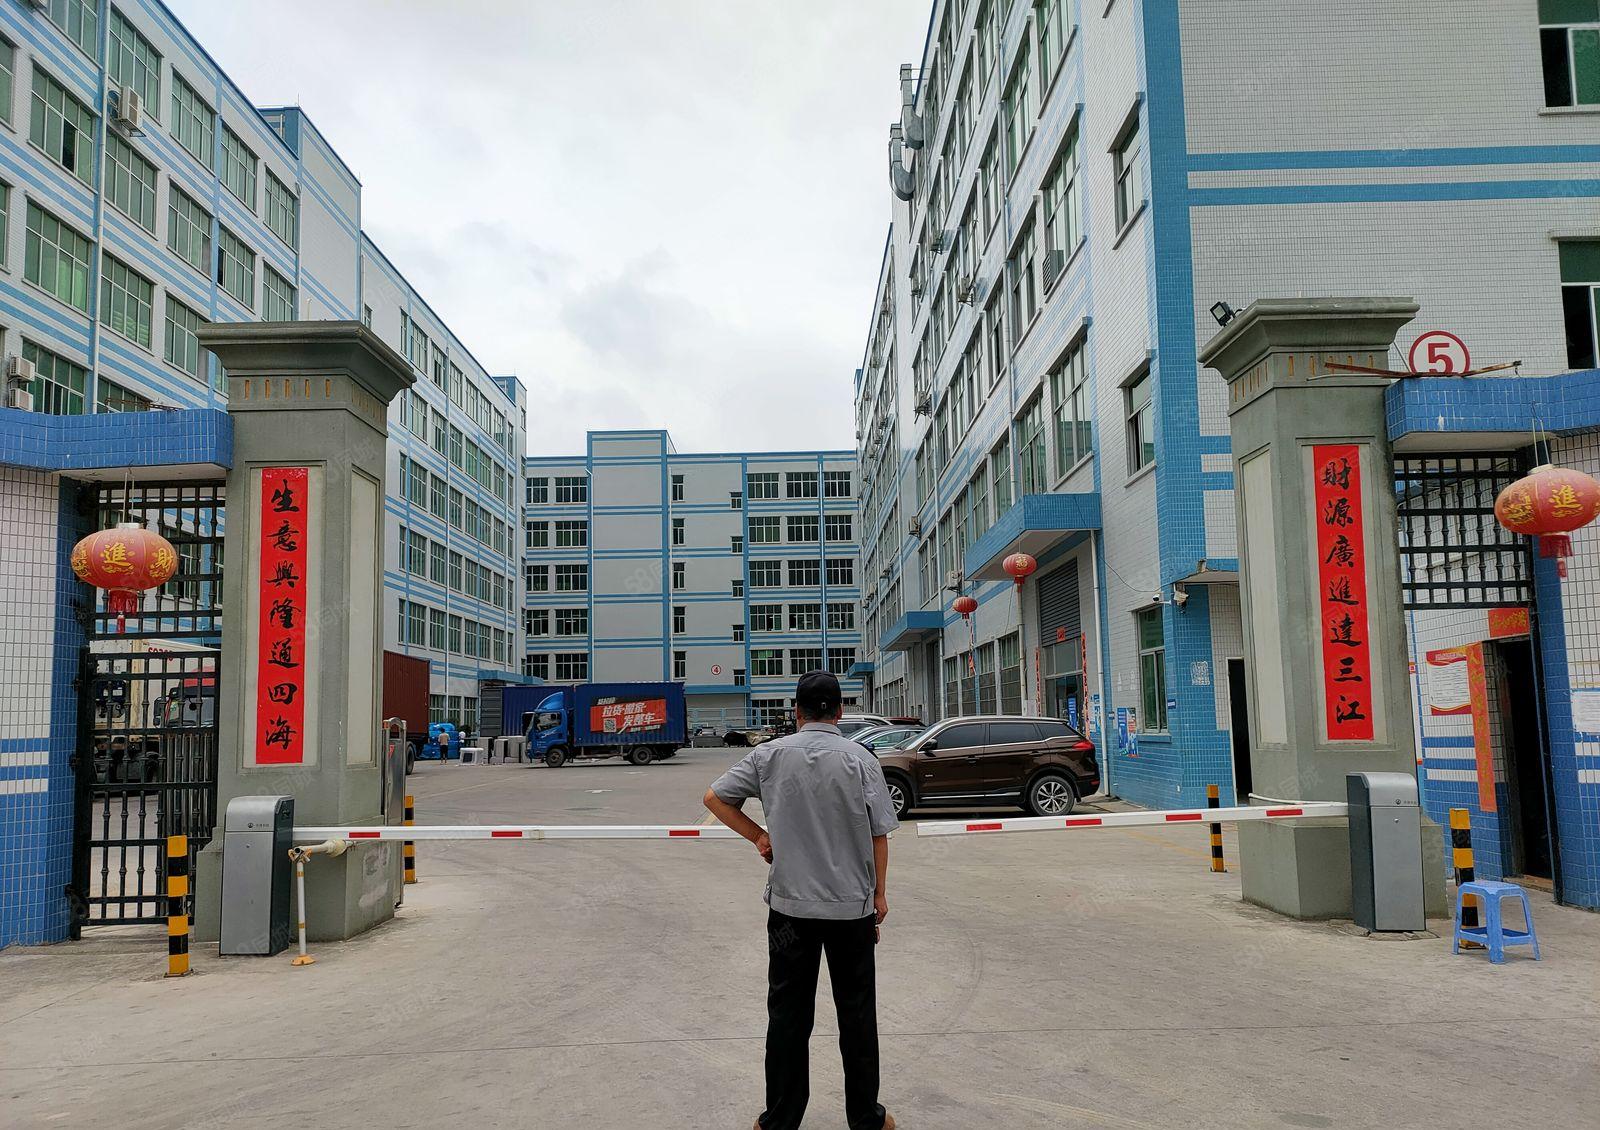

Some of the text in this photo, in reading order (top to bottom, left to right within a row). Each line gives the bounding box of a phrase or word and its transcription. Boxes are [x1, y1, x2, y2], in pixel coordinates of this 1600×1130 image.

[1427, 342, 1454, 374] 5
[265, 479, 301, 750] 生意興隆通四海
[1322, 458, 1366, 724] 財源廣進達三江
